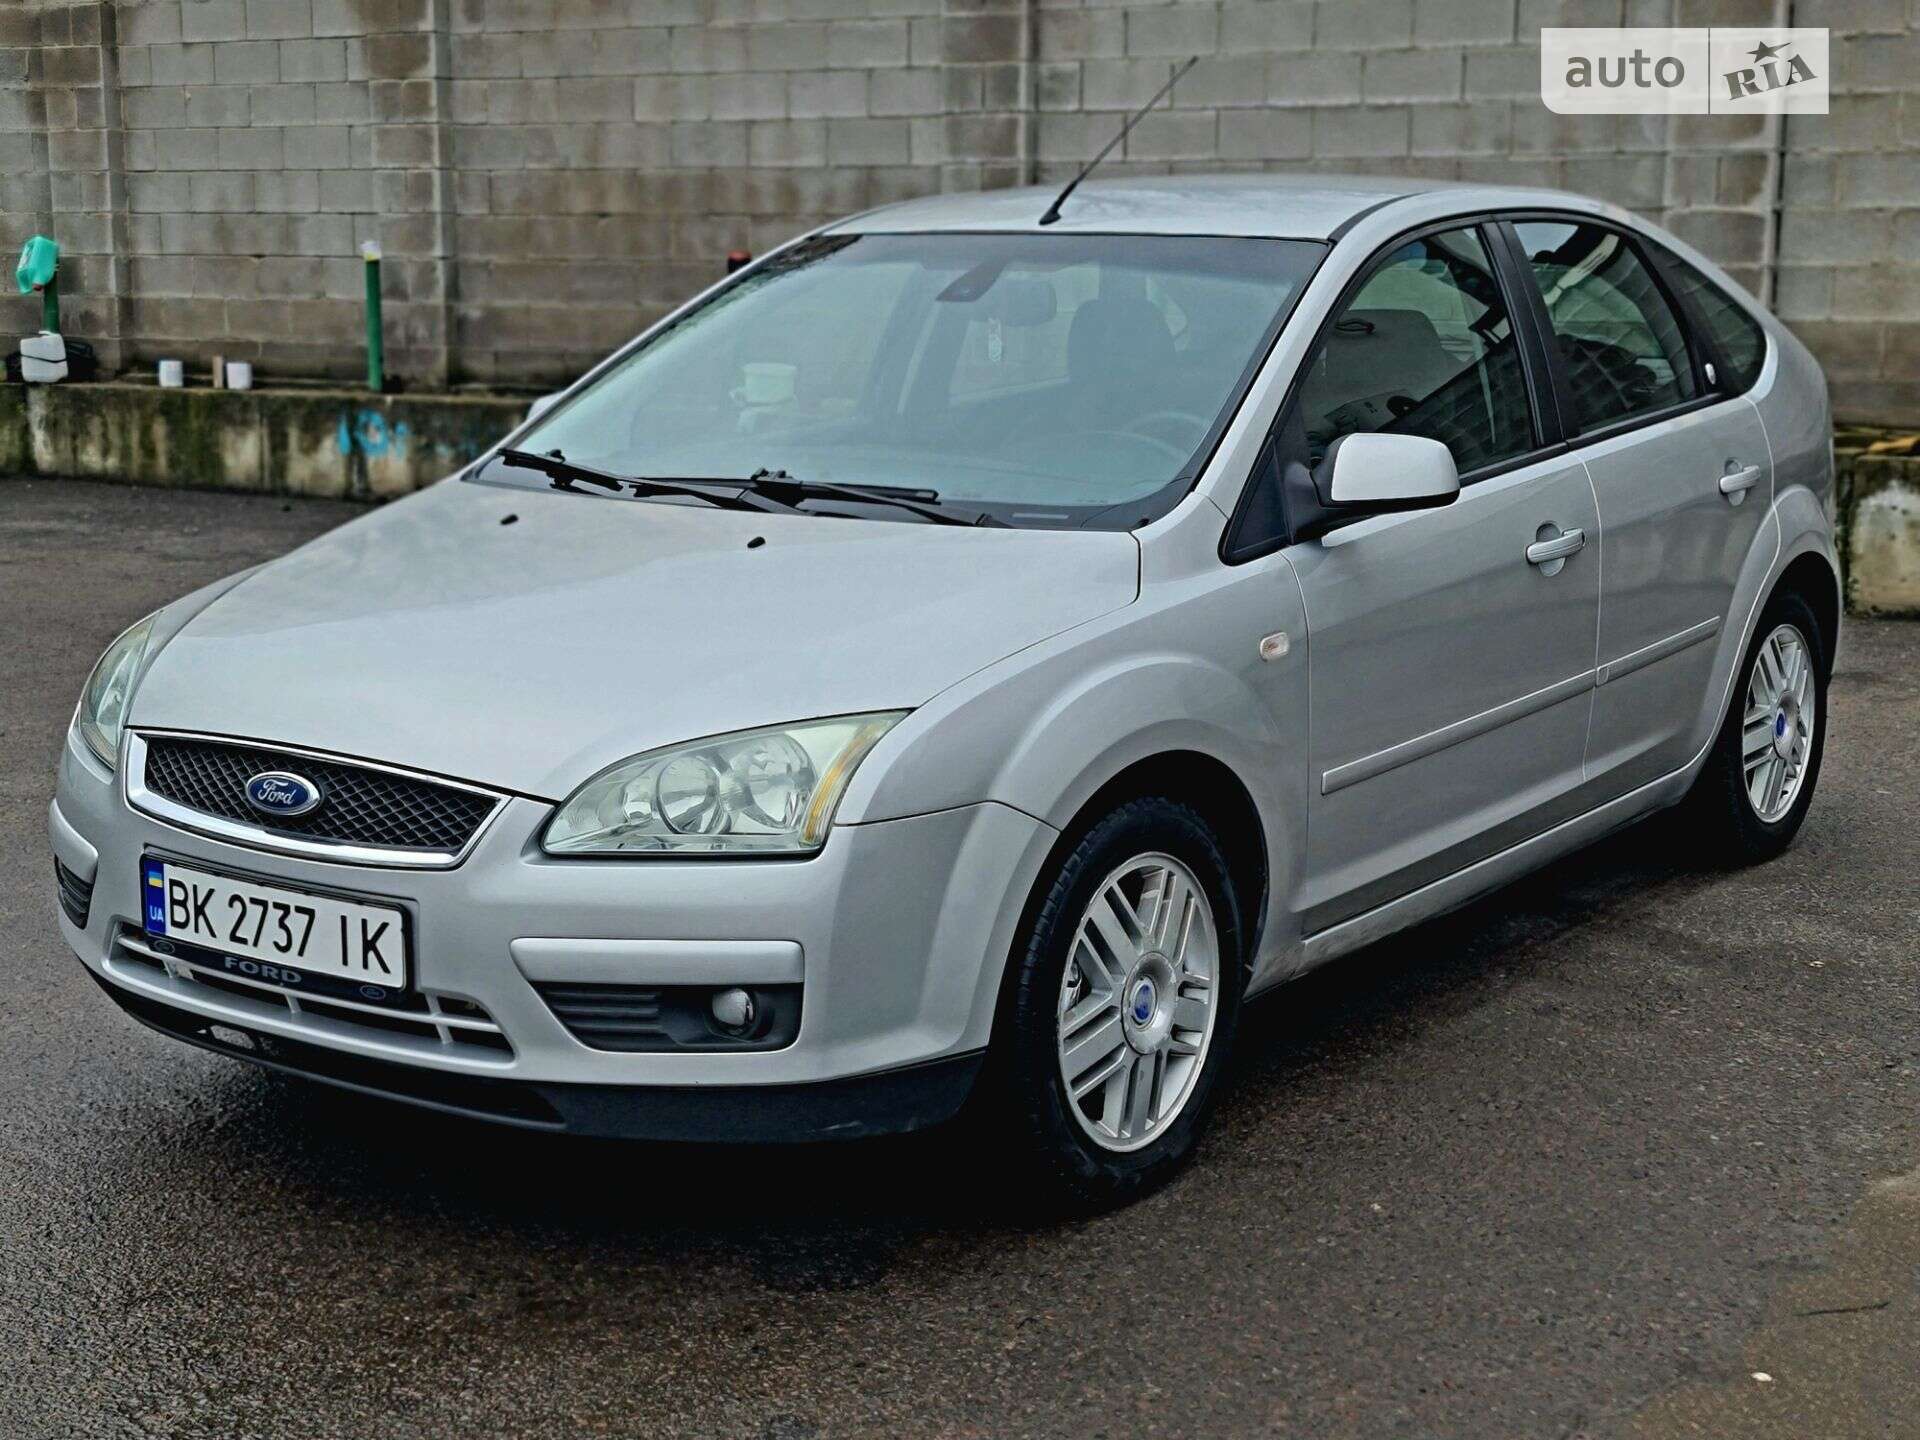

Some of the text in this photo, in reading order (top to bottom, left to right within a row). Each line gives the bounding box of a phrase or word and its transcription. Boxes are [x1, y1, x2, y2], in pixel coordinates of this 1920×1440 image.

[257, 779, 297, 805] Ford
[150, 905, 164, 922] UA
[168, 878, 391, 974] BK 2737 IK
[224, 956, 302, 983] FORD
